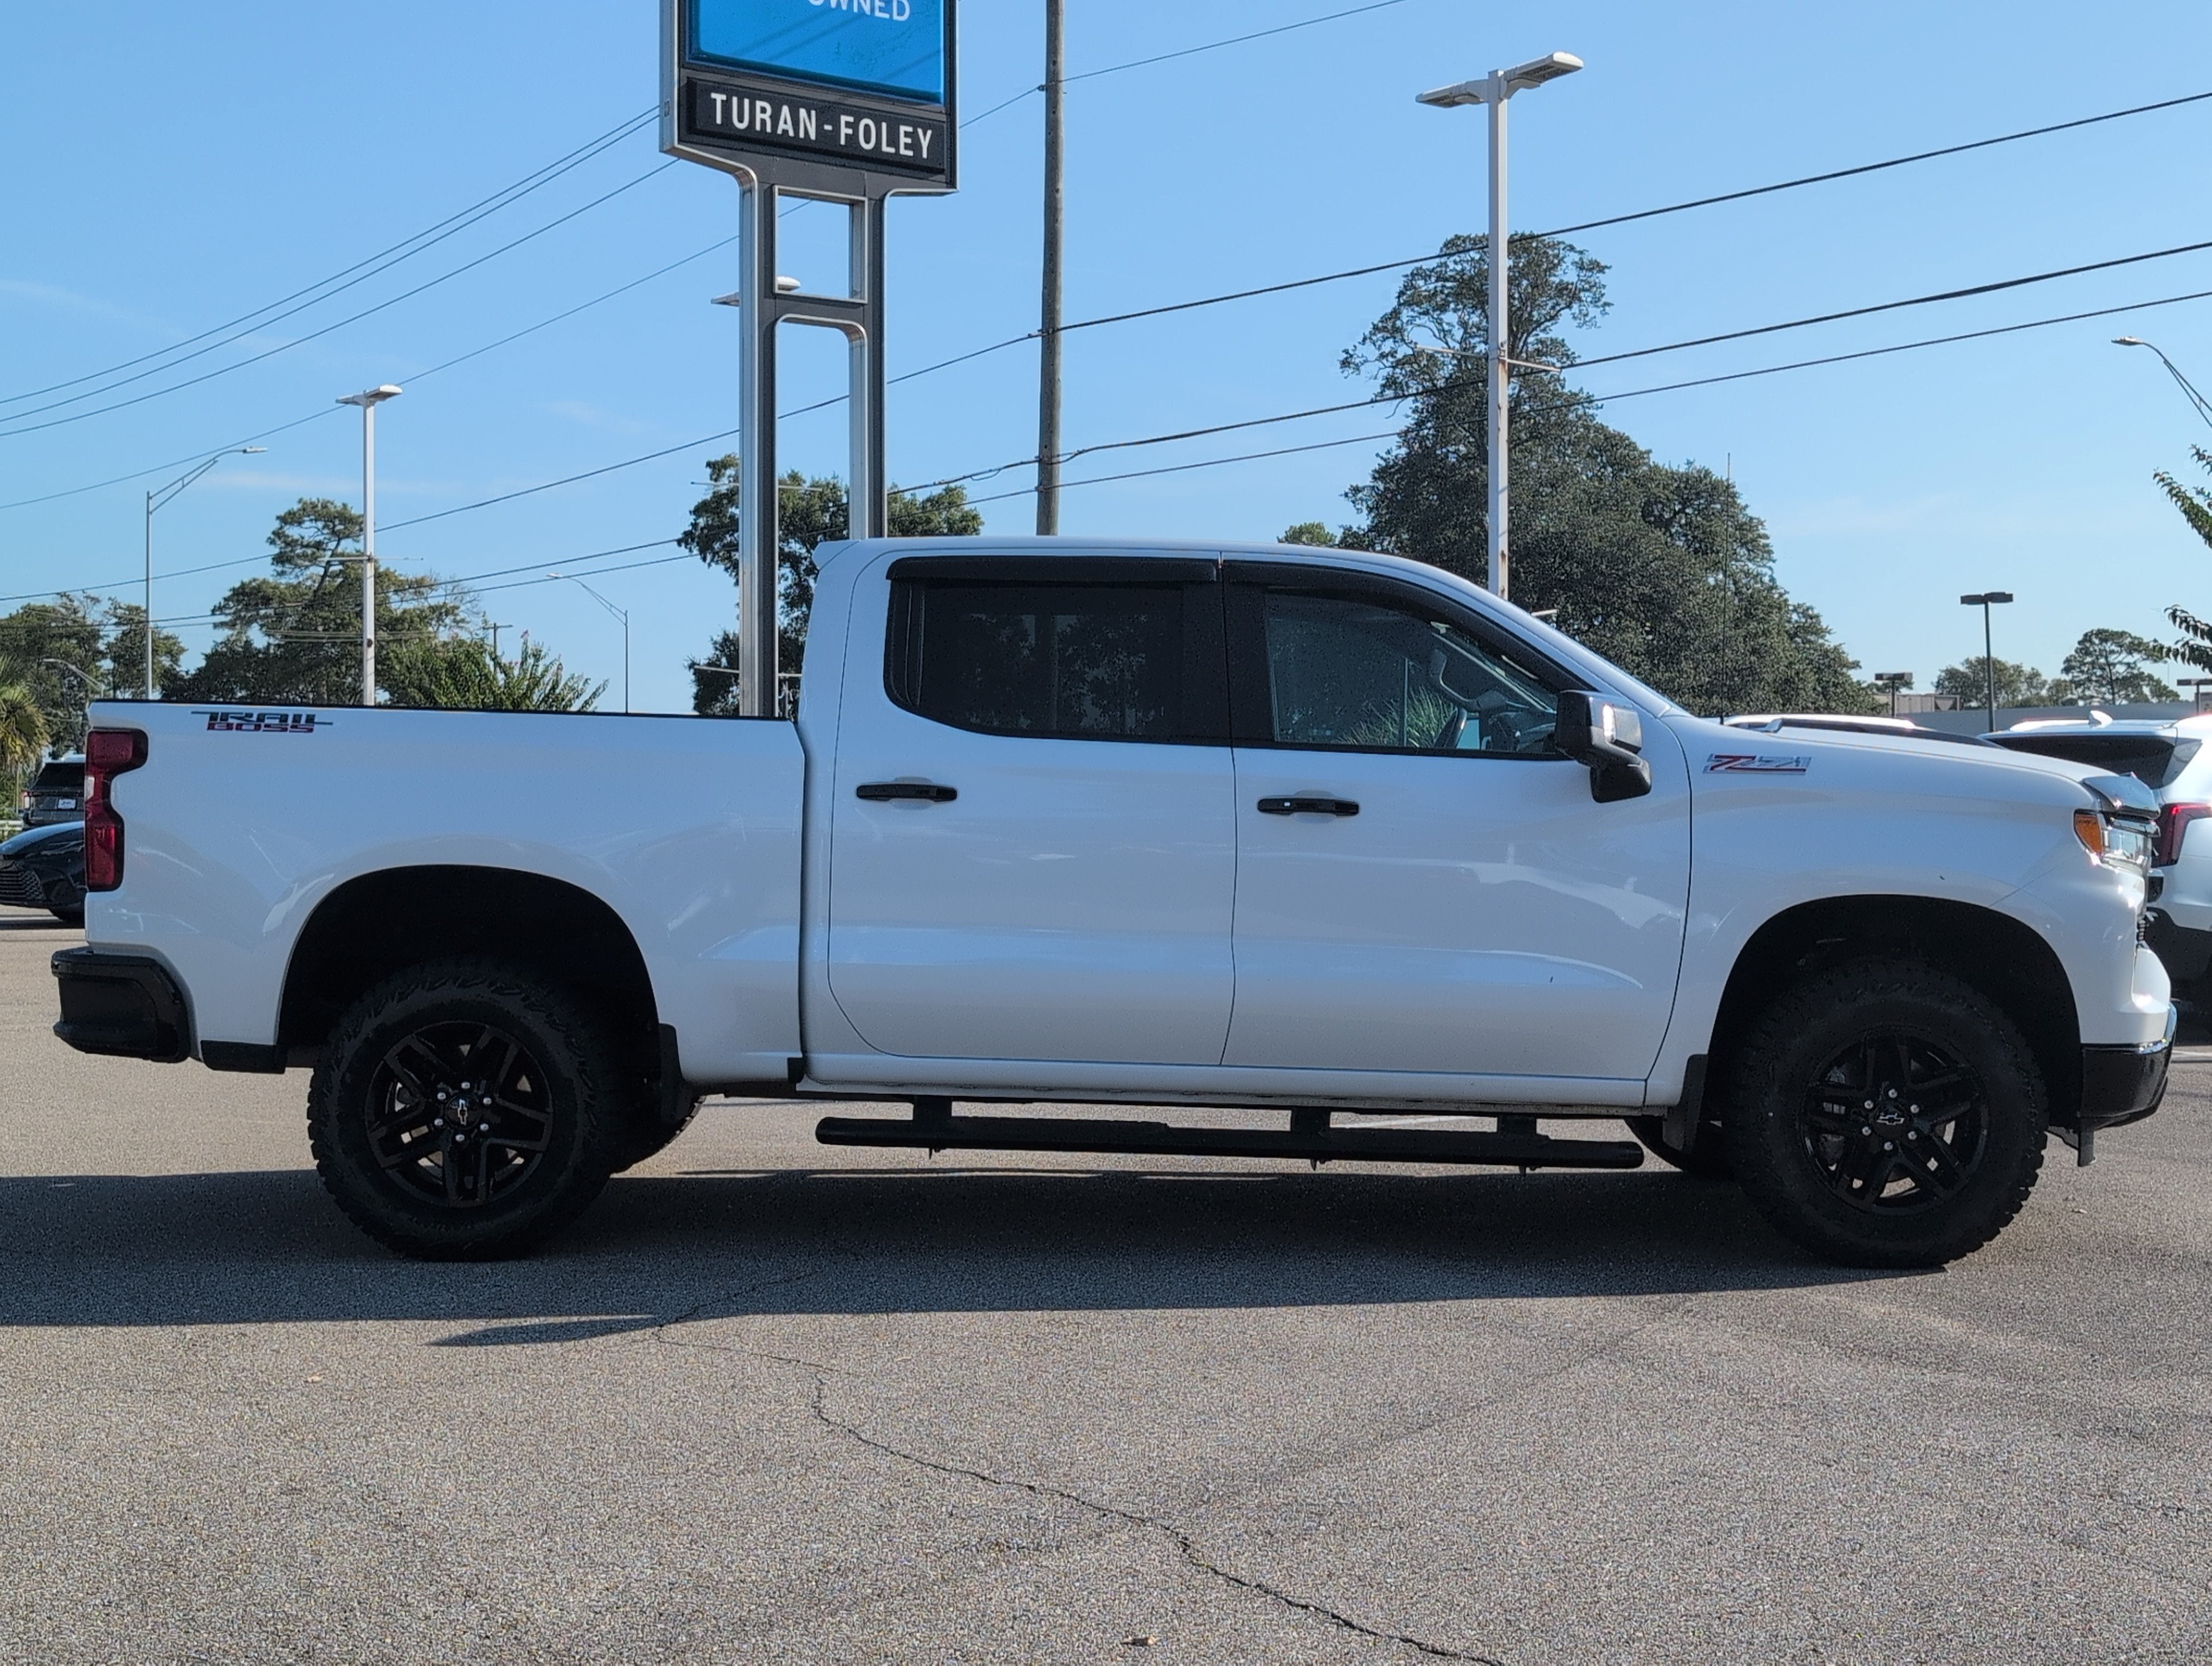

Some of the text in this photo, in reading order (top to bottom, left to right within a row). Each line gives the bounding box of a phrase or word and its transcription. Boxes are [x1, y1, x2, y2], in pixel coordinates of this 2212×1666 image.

[807, 0, 910, 21] NED
[710, 93, 933, 159] TURAN-FOLEY
[191, 711, 333, 726] TRAIL
[207, 722, 315, 733] BOSS
